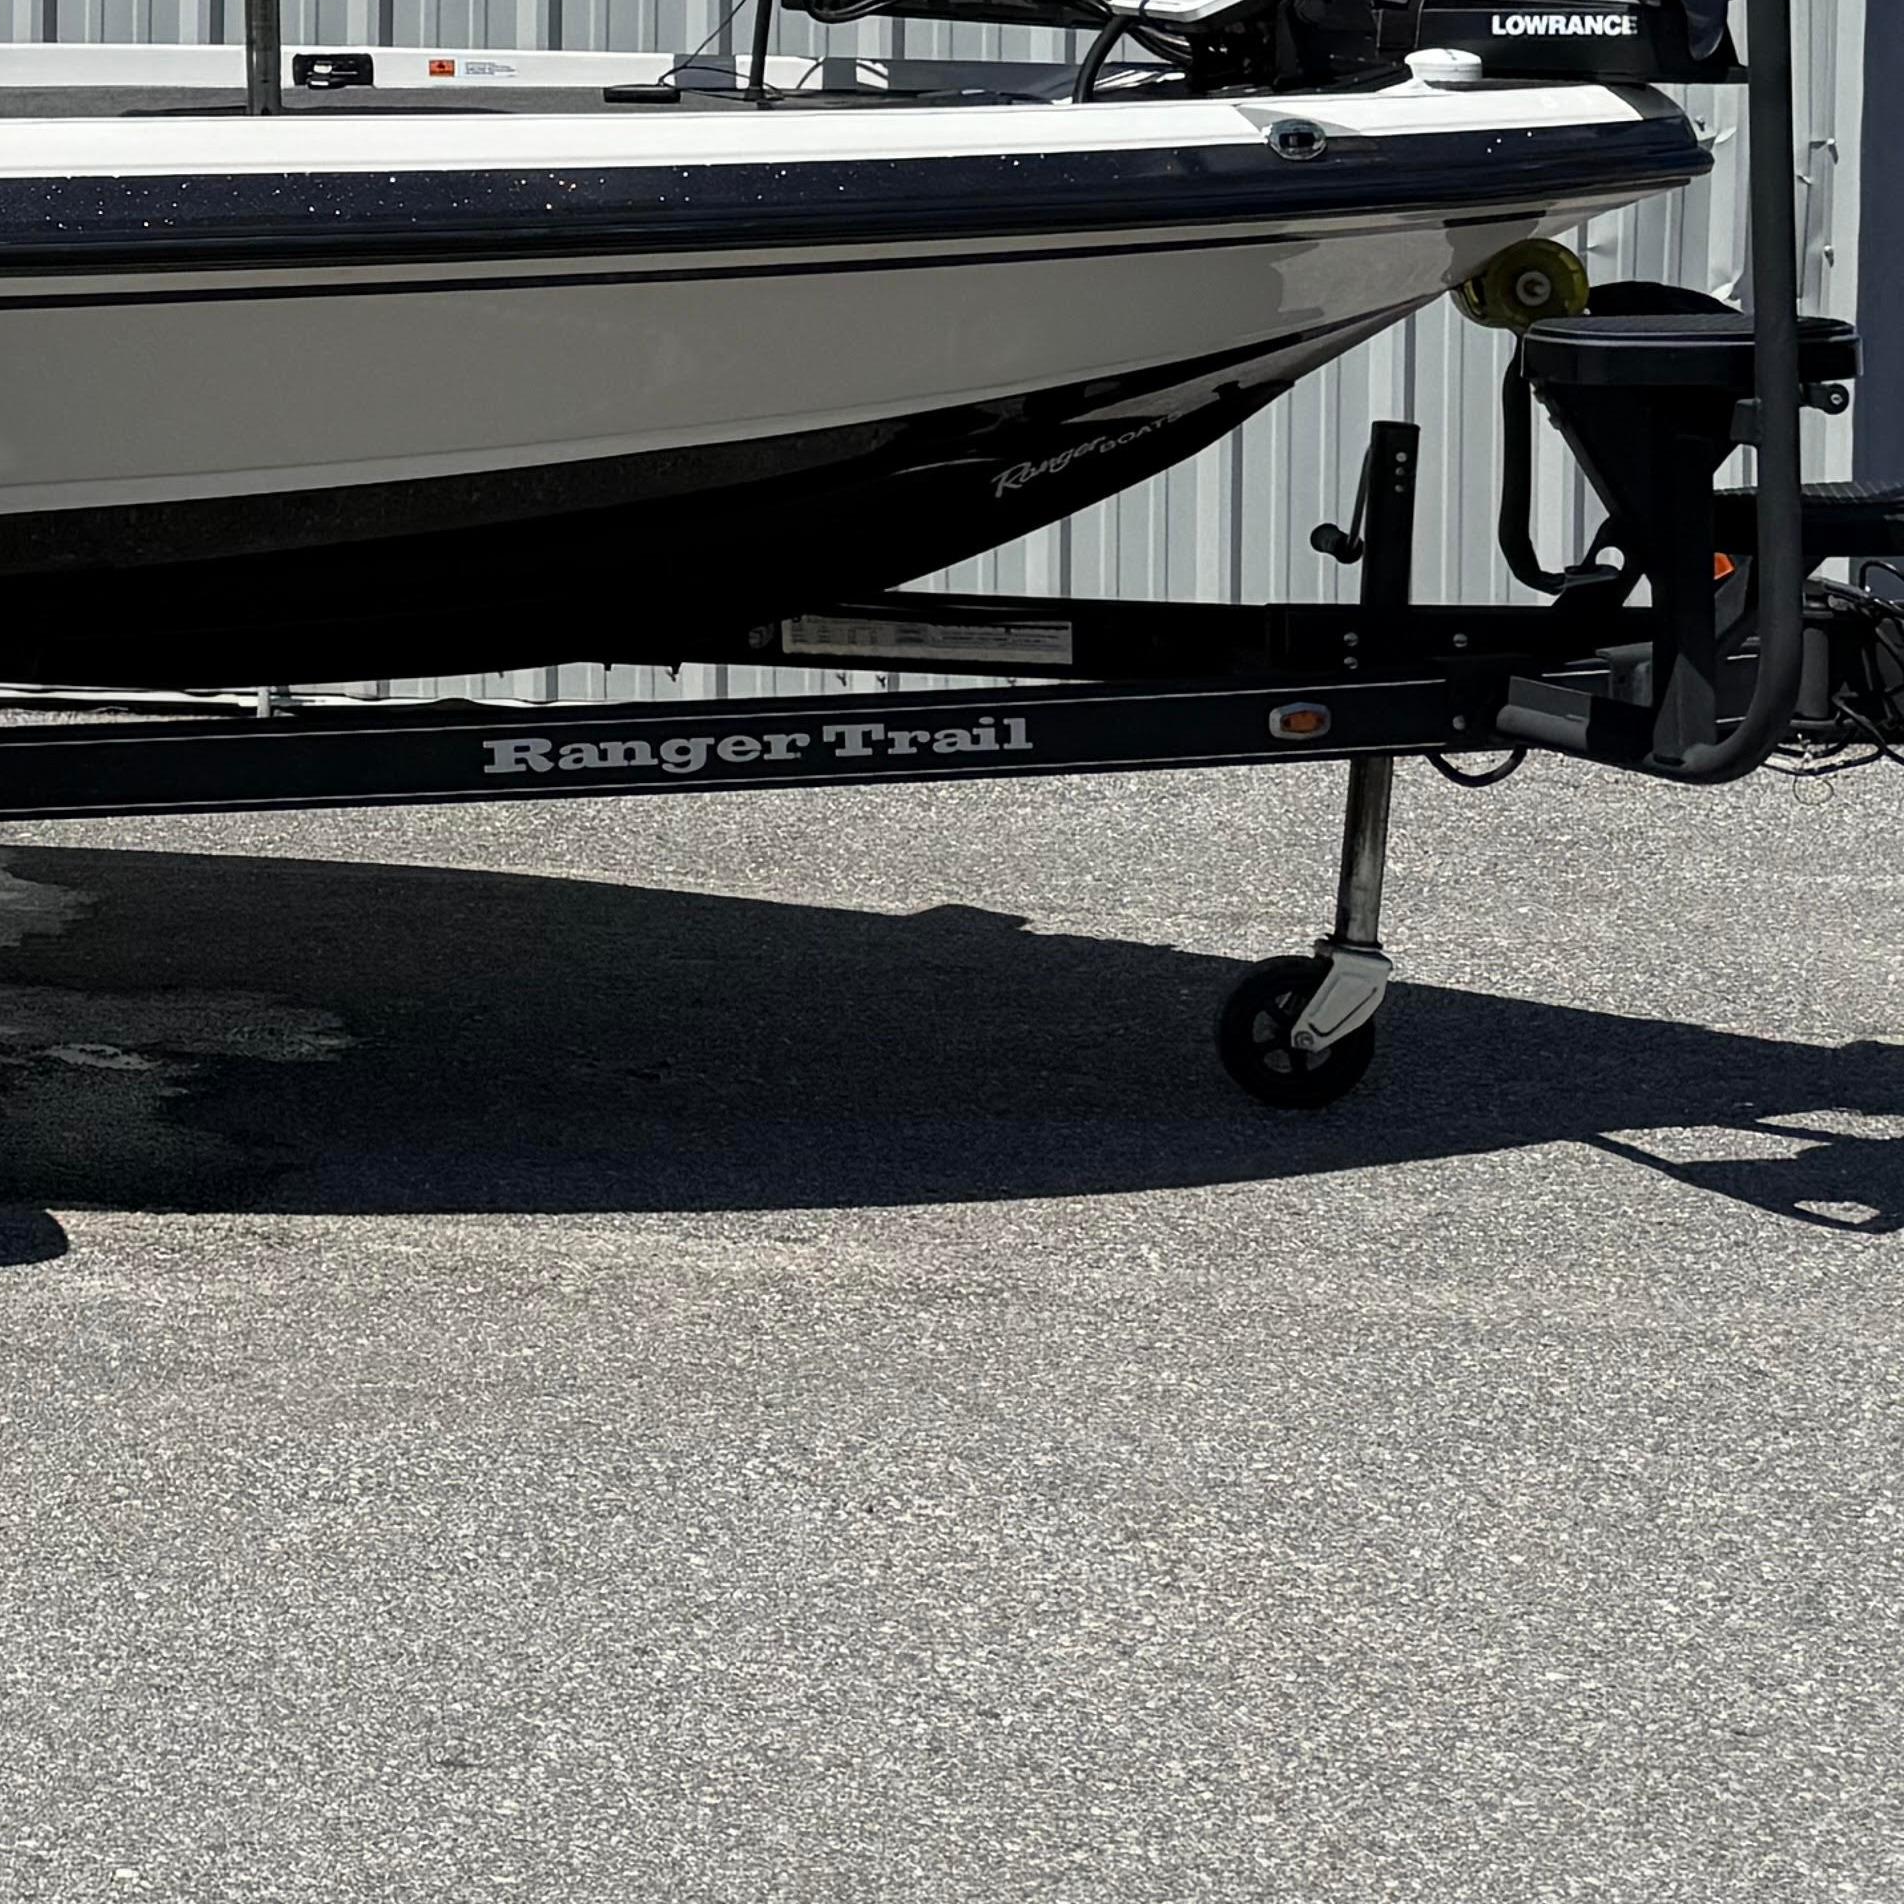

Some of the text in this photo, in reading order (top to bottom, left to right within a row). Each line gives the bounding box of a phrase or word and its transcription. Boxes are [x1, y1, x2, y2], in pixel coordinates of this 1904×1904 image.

[1492, 14, 1638, 35] LOWRANCE
[988, 435, 1108, 499] Ranger
[482, 717, 1033, 776] Ranger Trail
